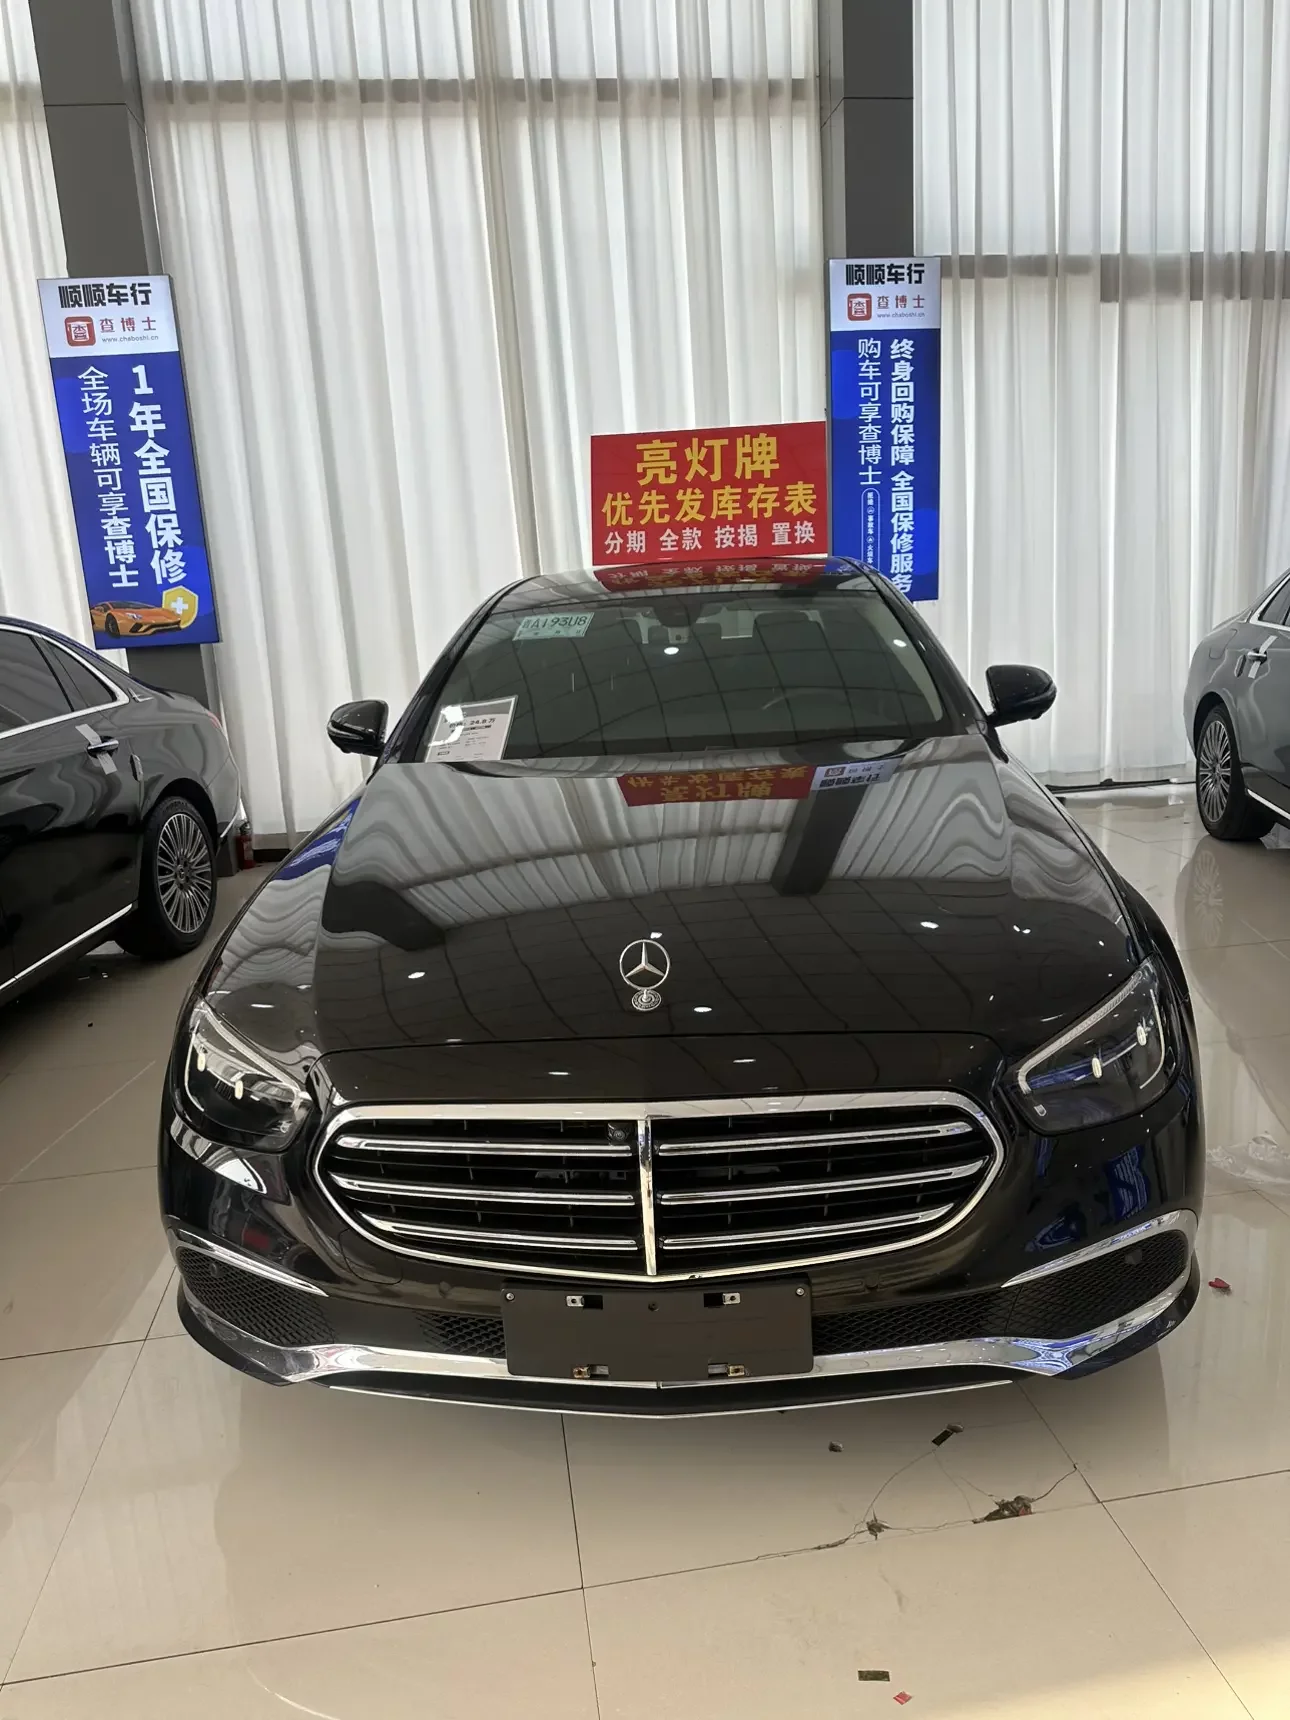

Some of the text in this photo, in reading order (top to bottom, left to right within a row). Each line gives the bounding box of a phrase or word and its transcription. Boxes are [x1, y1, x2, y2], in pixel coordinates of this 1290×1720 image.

[846, 263, 925, 286] 顺顺车行
[58, 282, 153, 309] 顺顺车行
[877, 294, 925, 310] 查博士
[99, 316, 157, 333] 查博士
[101, 334, 159, 344] www.chaboshi.cn
[858, 337, 882, 486] 购车可享查博士
[78, 365, 139, 588] 全场车辆可享查博士
[129, 364, 187, 585] 1年全国保修
[636, 432, 780, 487] 亮灯牌
[890, 338, 915, 593] 终身回购保障 全国保修服务
[601, 481, 817, 527] 优先发库存表
[604, 520, 815, 555] 分期 全款 按揭 置换
